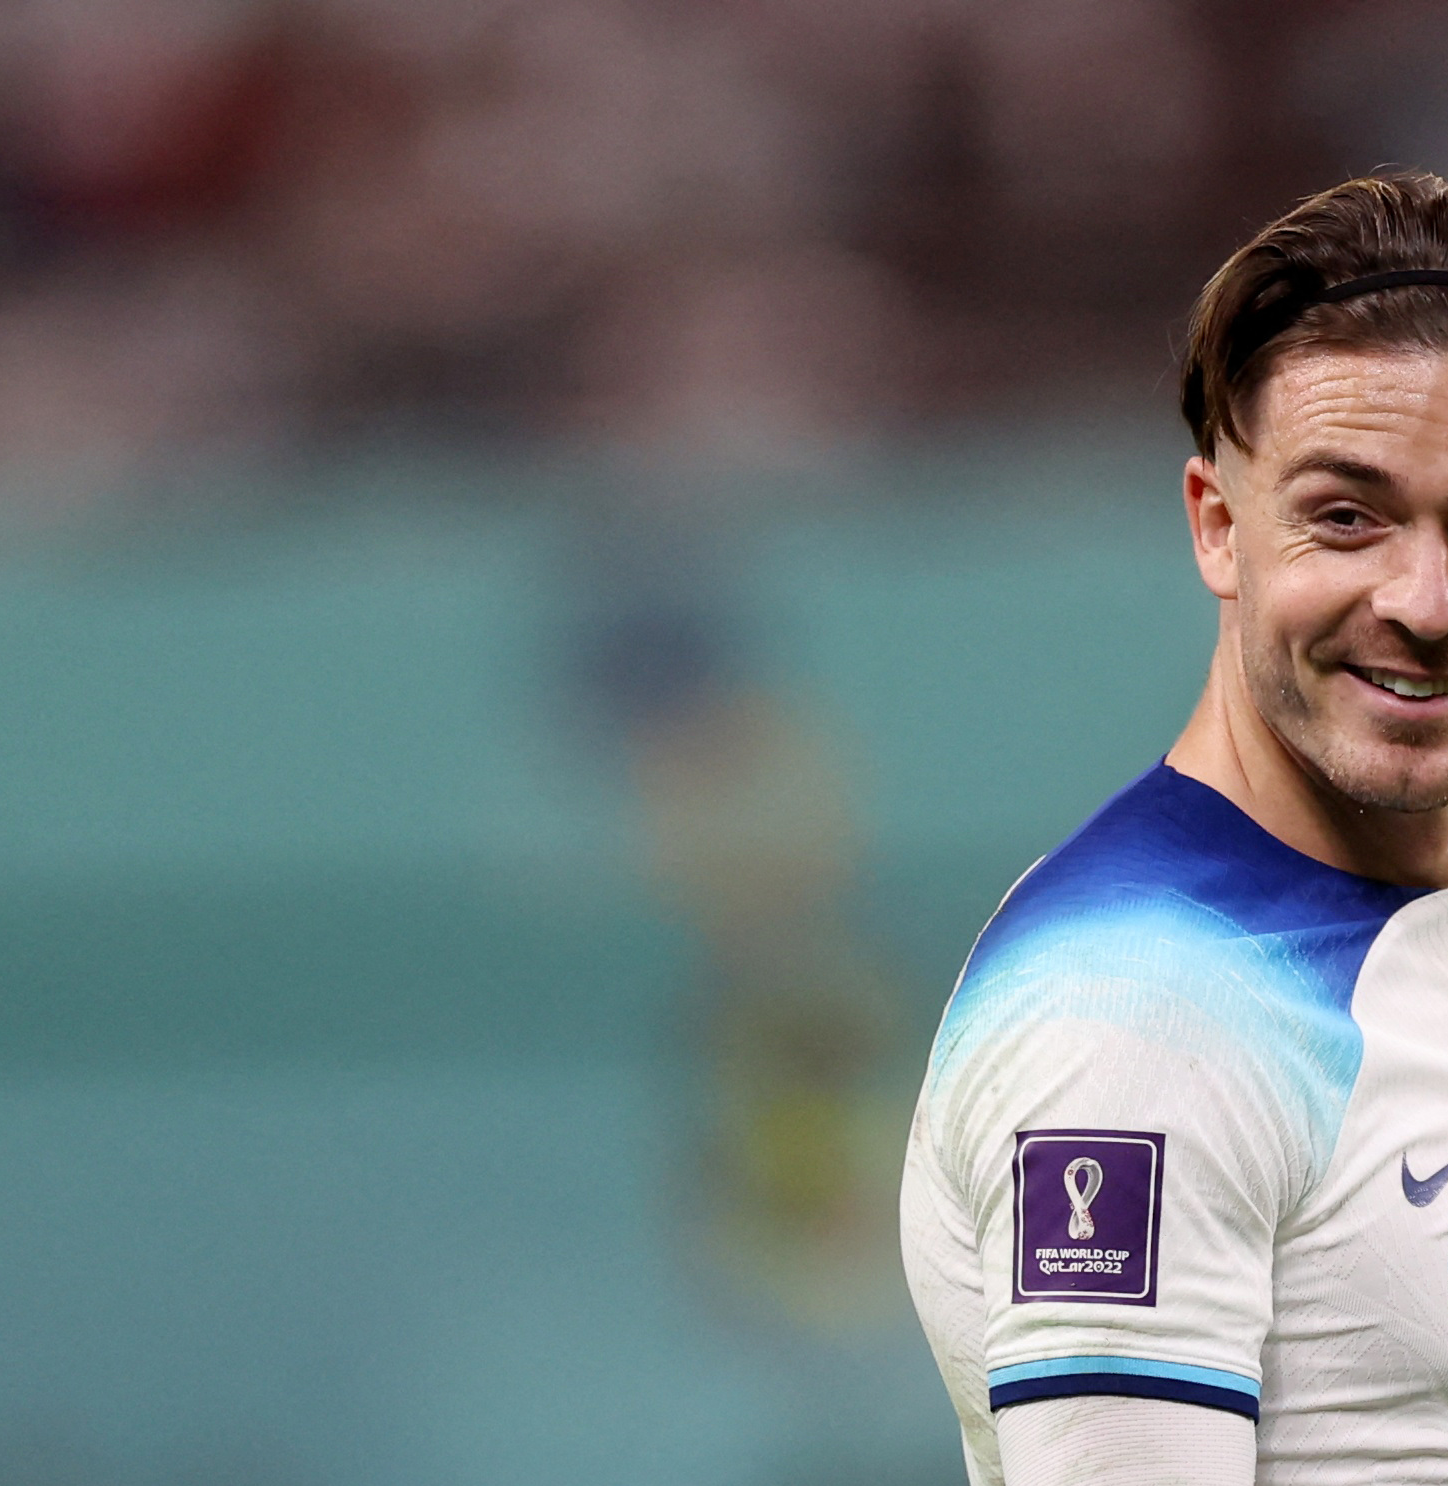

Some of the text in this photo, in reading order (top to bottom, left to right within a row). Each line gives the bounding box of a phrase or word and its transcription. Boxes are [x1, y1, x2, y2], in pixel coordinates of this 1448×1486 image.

[1035, 1248, 1130, 1261] FIFA WORLD CUP
